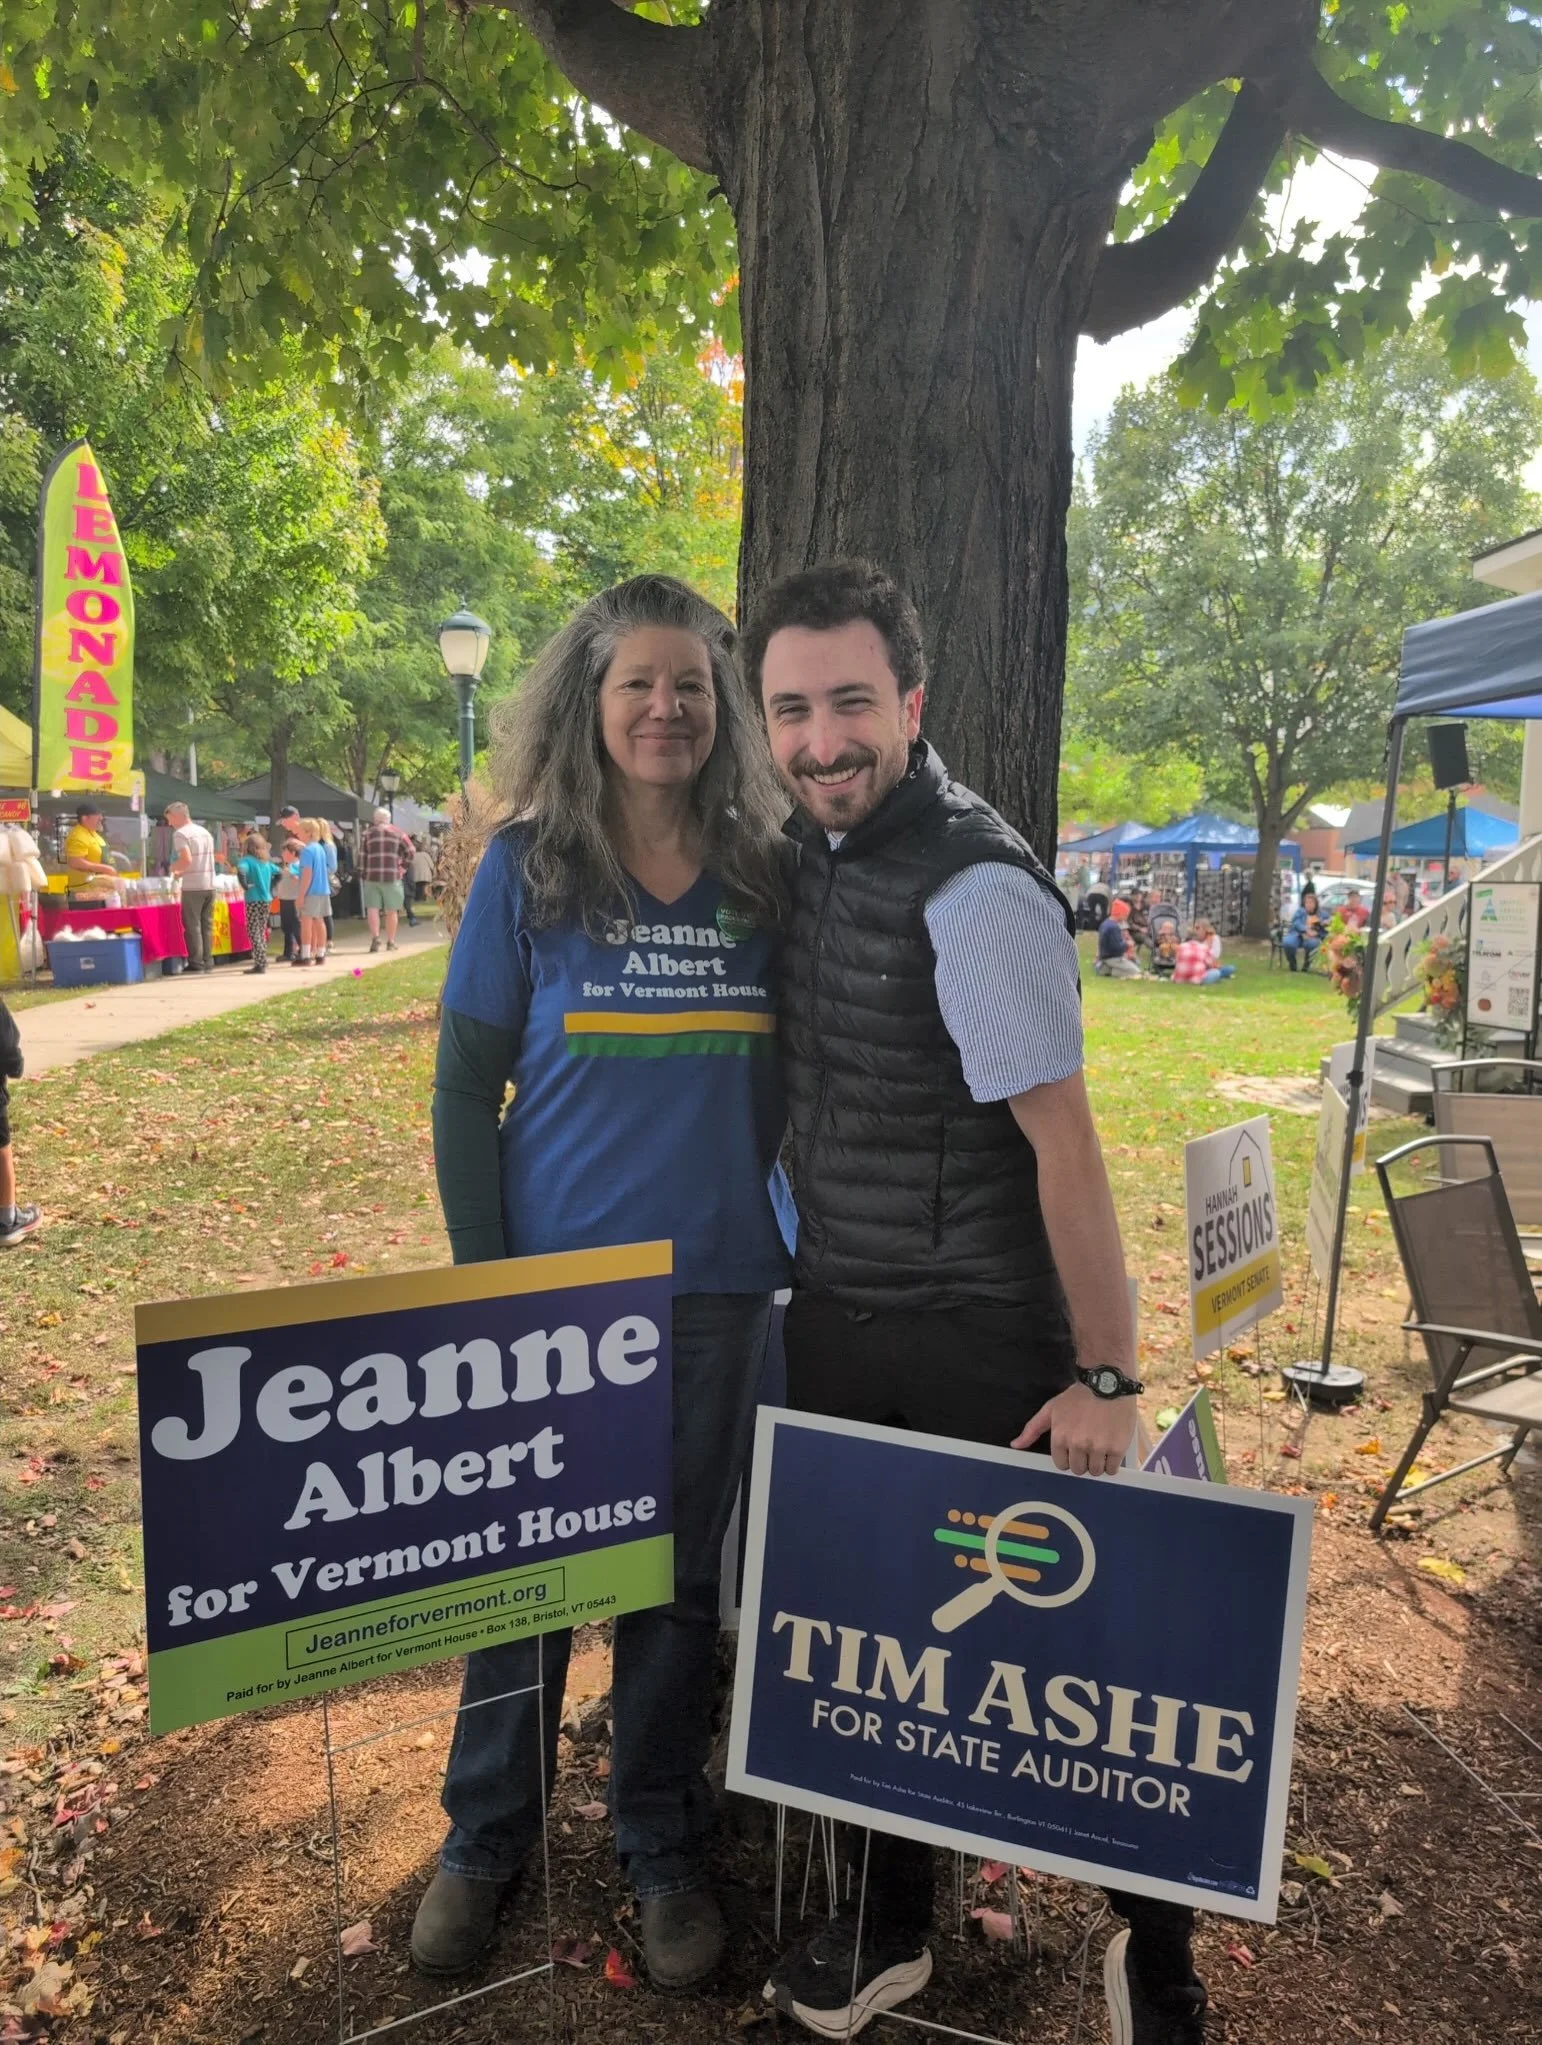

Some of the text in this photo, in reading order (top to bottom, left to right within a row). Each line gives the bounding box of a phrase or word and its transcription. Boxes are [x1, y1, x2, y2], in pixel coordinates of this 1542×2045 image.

[65, 462, 124, 782] LEMONADE
[582, 982, 767, 998] for Vermont House
[622, 951, 727, 977] Albert
[1193, 1191, 1273, 1282] SESSIONS
[1205, 1184, 1238, 1215] HANNAH
[1211, 1265, 1271, 1313] VERMONT SENATE
[151, 1314, 660, 1460] Jeanne
[283, 1426, 564, 1531] Albert
[168, 1495, 657, 1627] for Vermont House
[226, 1595, 617, 1702] Paid for by Jeanne Albert for Vermont House Box 138, Bristol, VT 05443
[306, 1583, 547, 1654] Jeanneforvermont.org
[772, 1611, 1255, 1783] TIM ASHE
[812, 1698, 1190, 1817] FOR STATE AUDITOR
[850, 1773, 863, 1783] Paid
[872, 1779, 880, 1788] by
[892, 1785, 907, 1794] Ashe
[907, 1788, 916, 1796] for
[1038, 1820, 1046, 1828] VT
